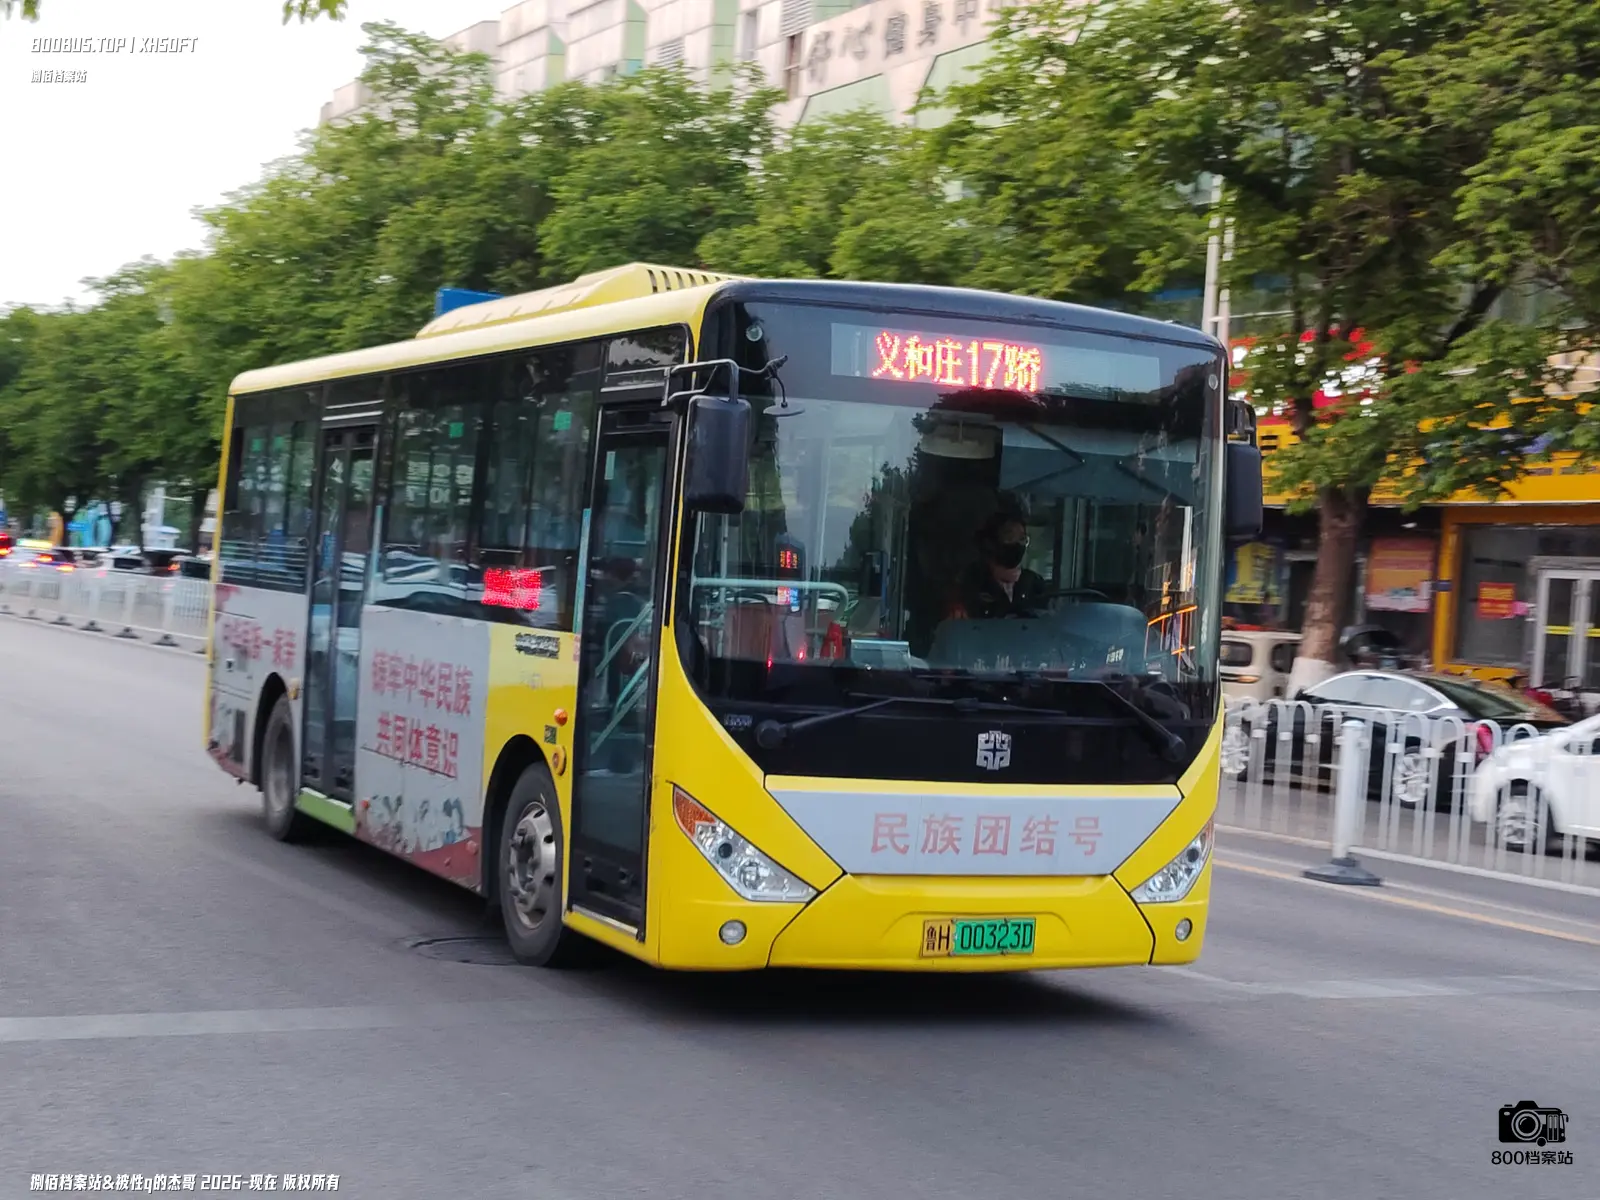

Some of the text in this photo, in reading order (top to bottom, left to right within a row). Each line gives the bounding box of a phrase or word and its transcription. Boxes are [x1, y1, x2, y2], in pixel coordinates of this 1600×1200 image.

[376, 711, 459, 779] 共同体意识
[870, 812, 1104, 856] 民族团结号
